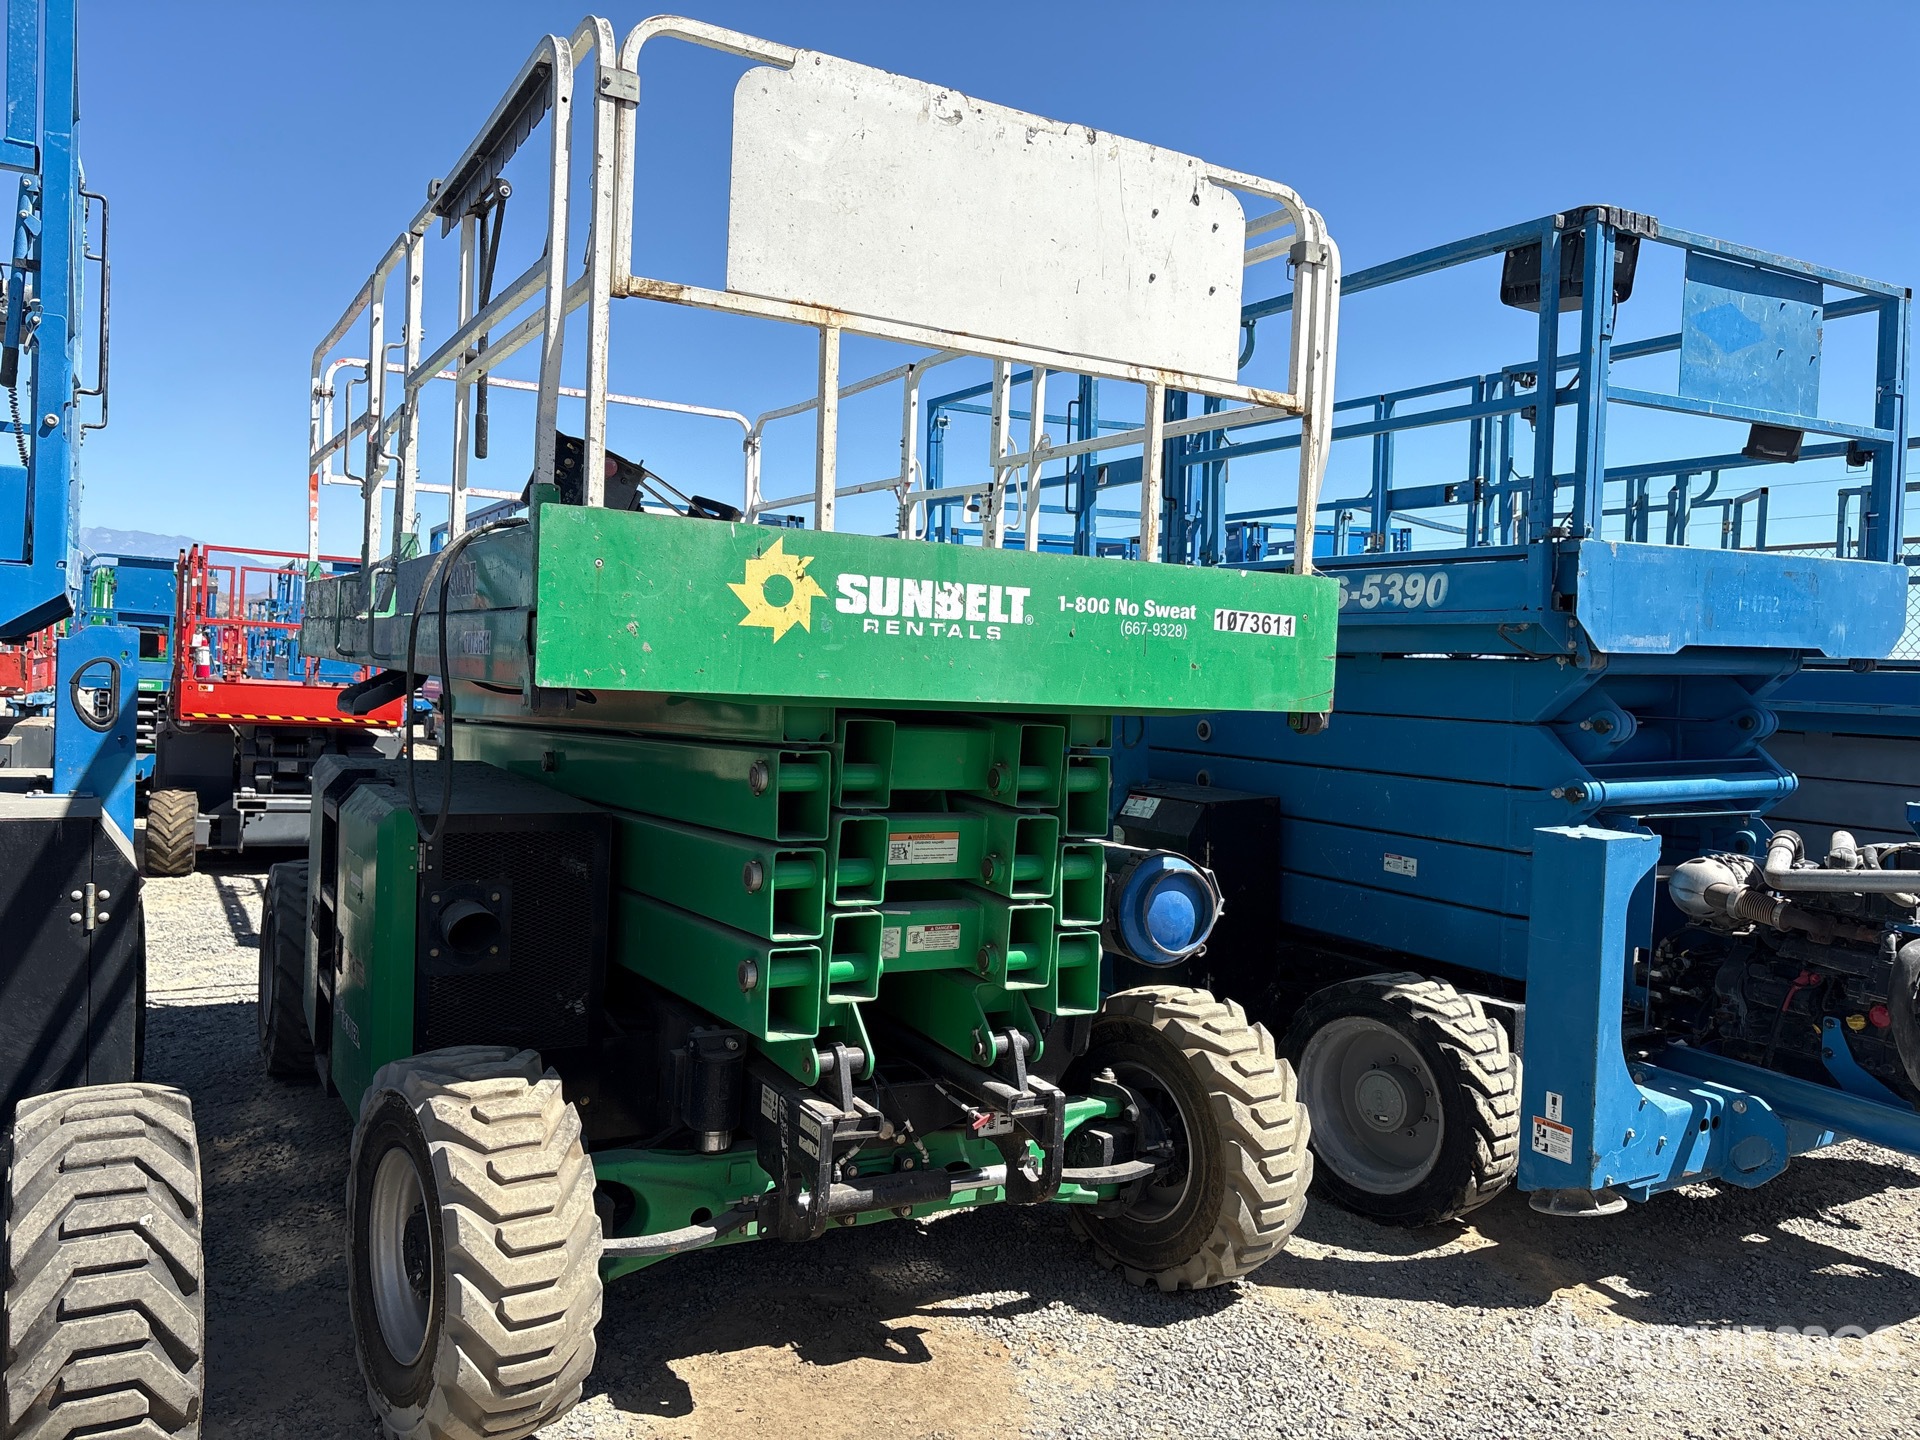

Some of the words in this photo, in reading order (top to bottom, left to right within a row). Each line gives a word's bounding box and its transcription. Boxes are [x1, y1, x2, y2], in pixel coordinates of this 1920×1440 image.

[1058, 595, 1110, 615] 1-800
[1115, 598, 1139, 617] No
[1144, 600, 1197, 620] Sweat
[863, 618, 1002, 641] RENTALS
[1120, 619, 1188, 640] (667-9328)
[1216, 610, 1293, 636] 1073611
